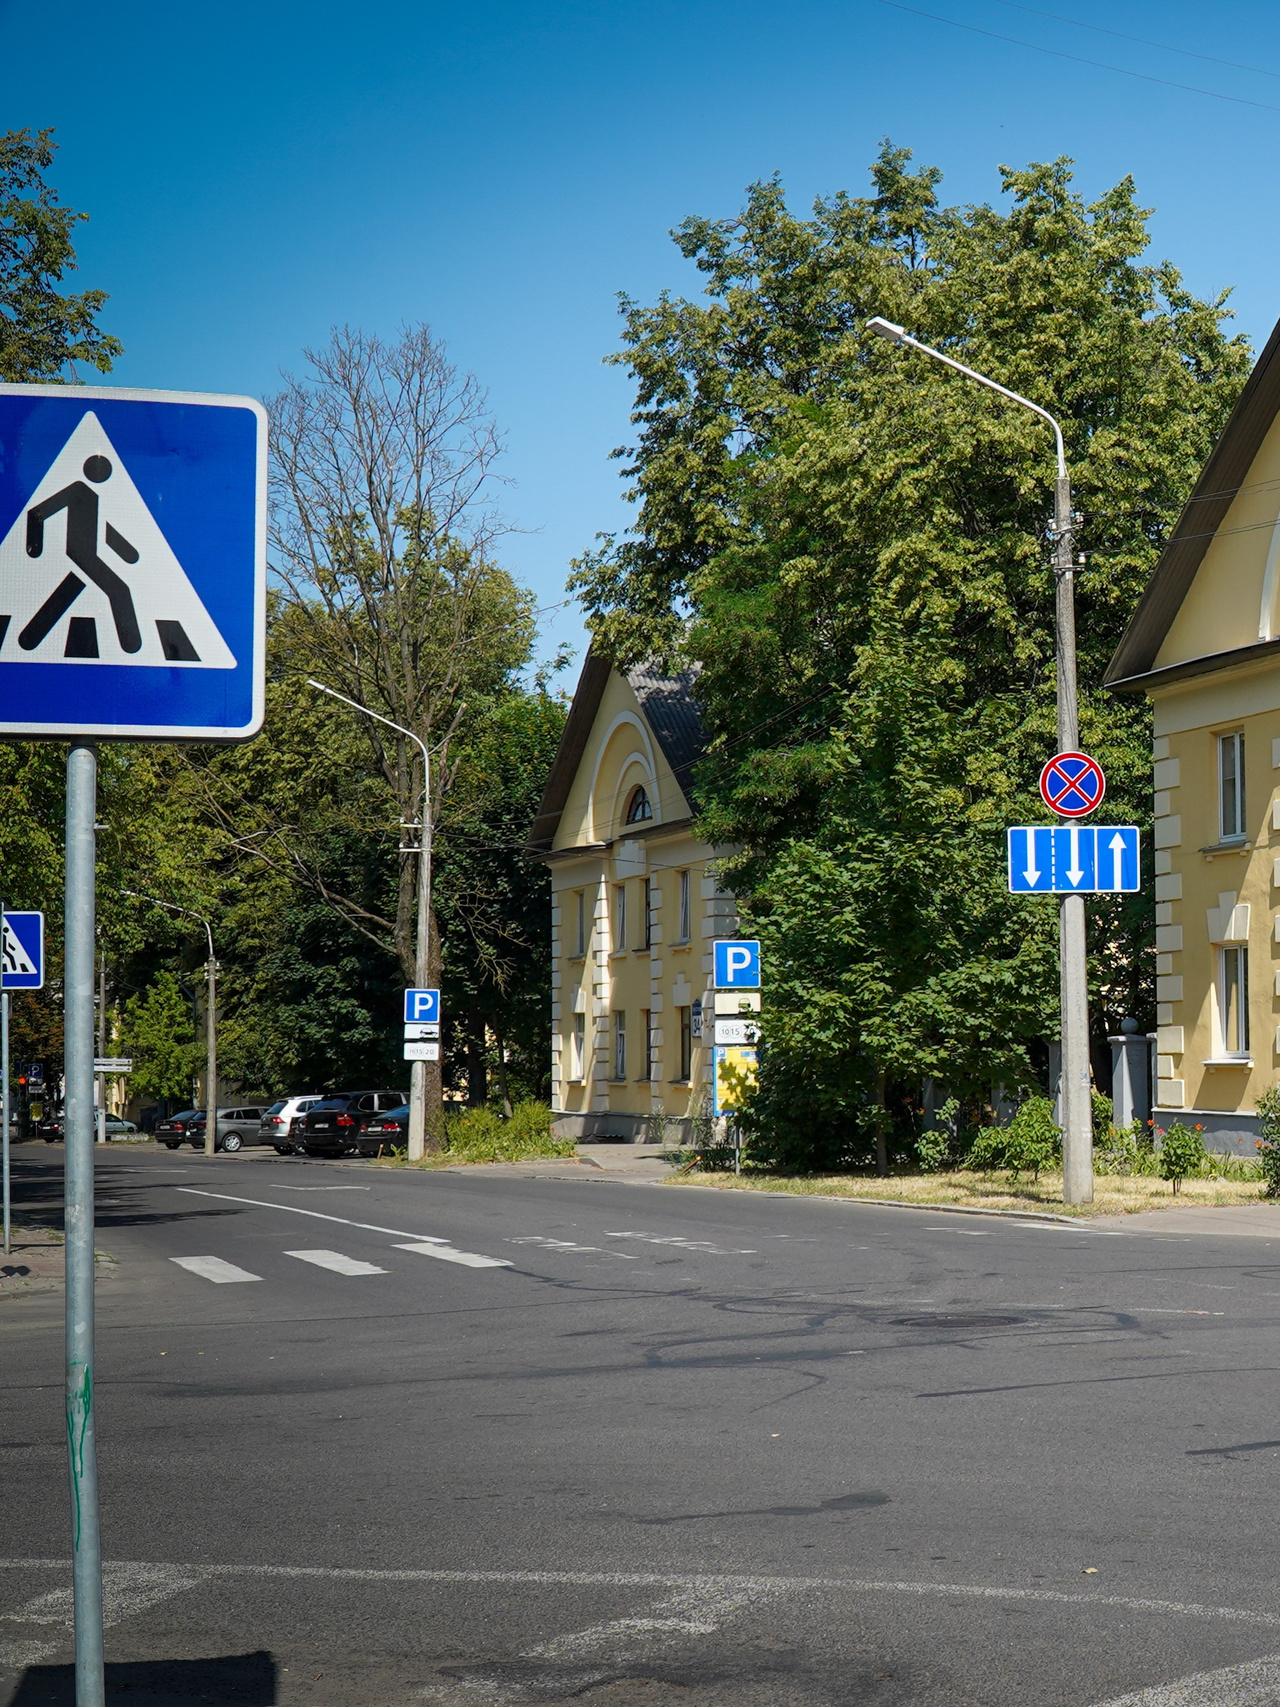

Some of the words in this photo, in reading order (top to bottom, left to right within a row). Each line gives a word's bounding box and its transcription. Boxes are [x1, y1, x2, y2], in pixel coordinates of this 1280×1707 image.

[727, 947, 751, 982] P
[414, 993, 433, 1019] P
[731, 1028, 740, 1036] 15
[31, 1065, 40, 1076] P
